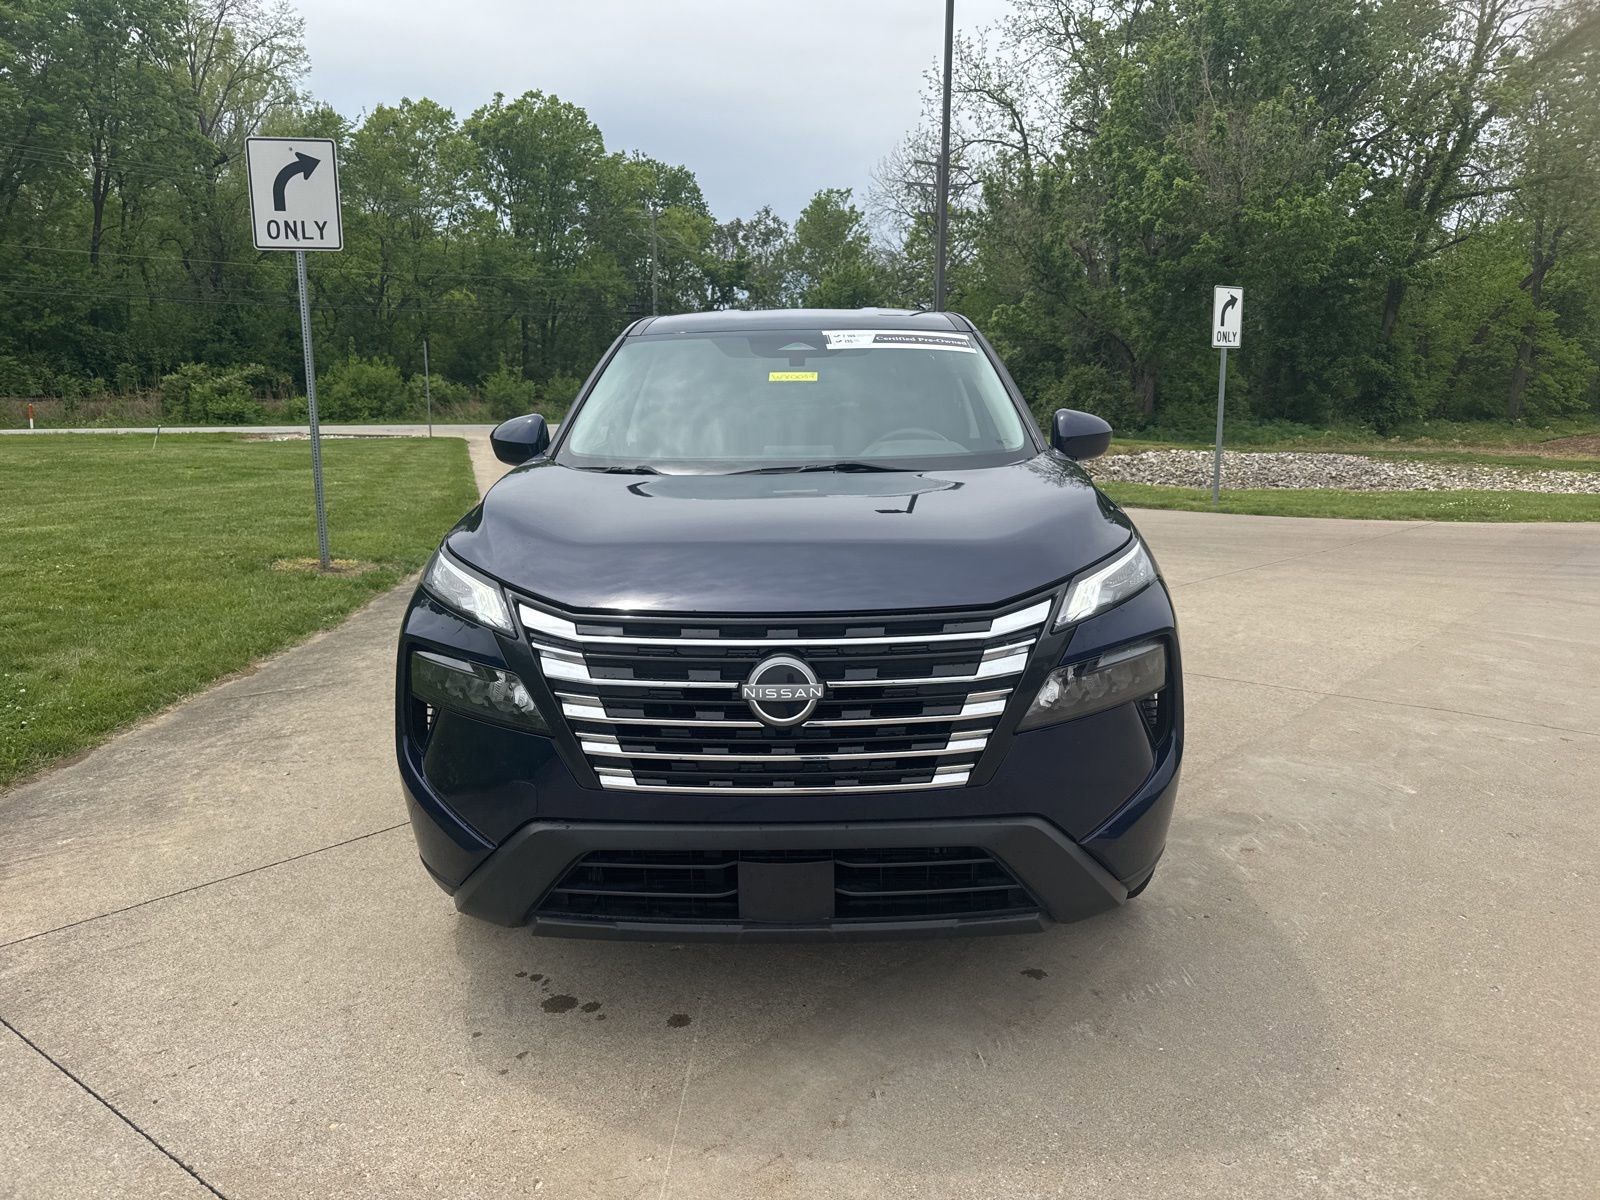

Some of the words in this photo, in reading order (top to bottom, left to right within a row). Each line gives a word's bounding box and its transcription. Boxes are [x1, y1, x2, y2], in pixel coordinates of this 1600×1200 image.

[266, 219, 328, 240] ONLY
[918, 337, 967, 345] Pre-Owned
[1216, 330, 1237, 343] ONLY
[743, 687, 822, 699] NISSAN
